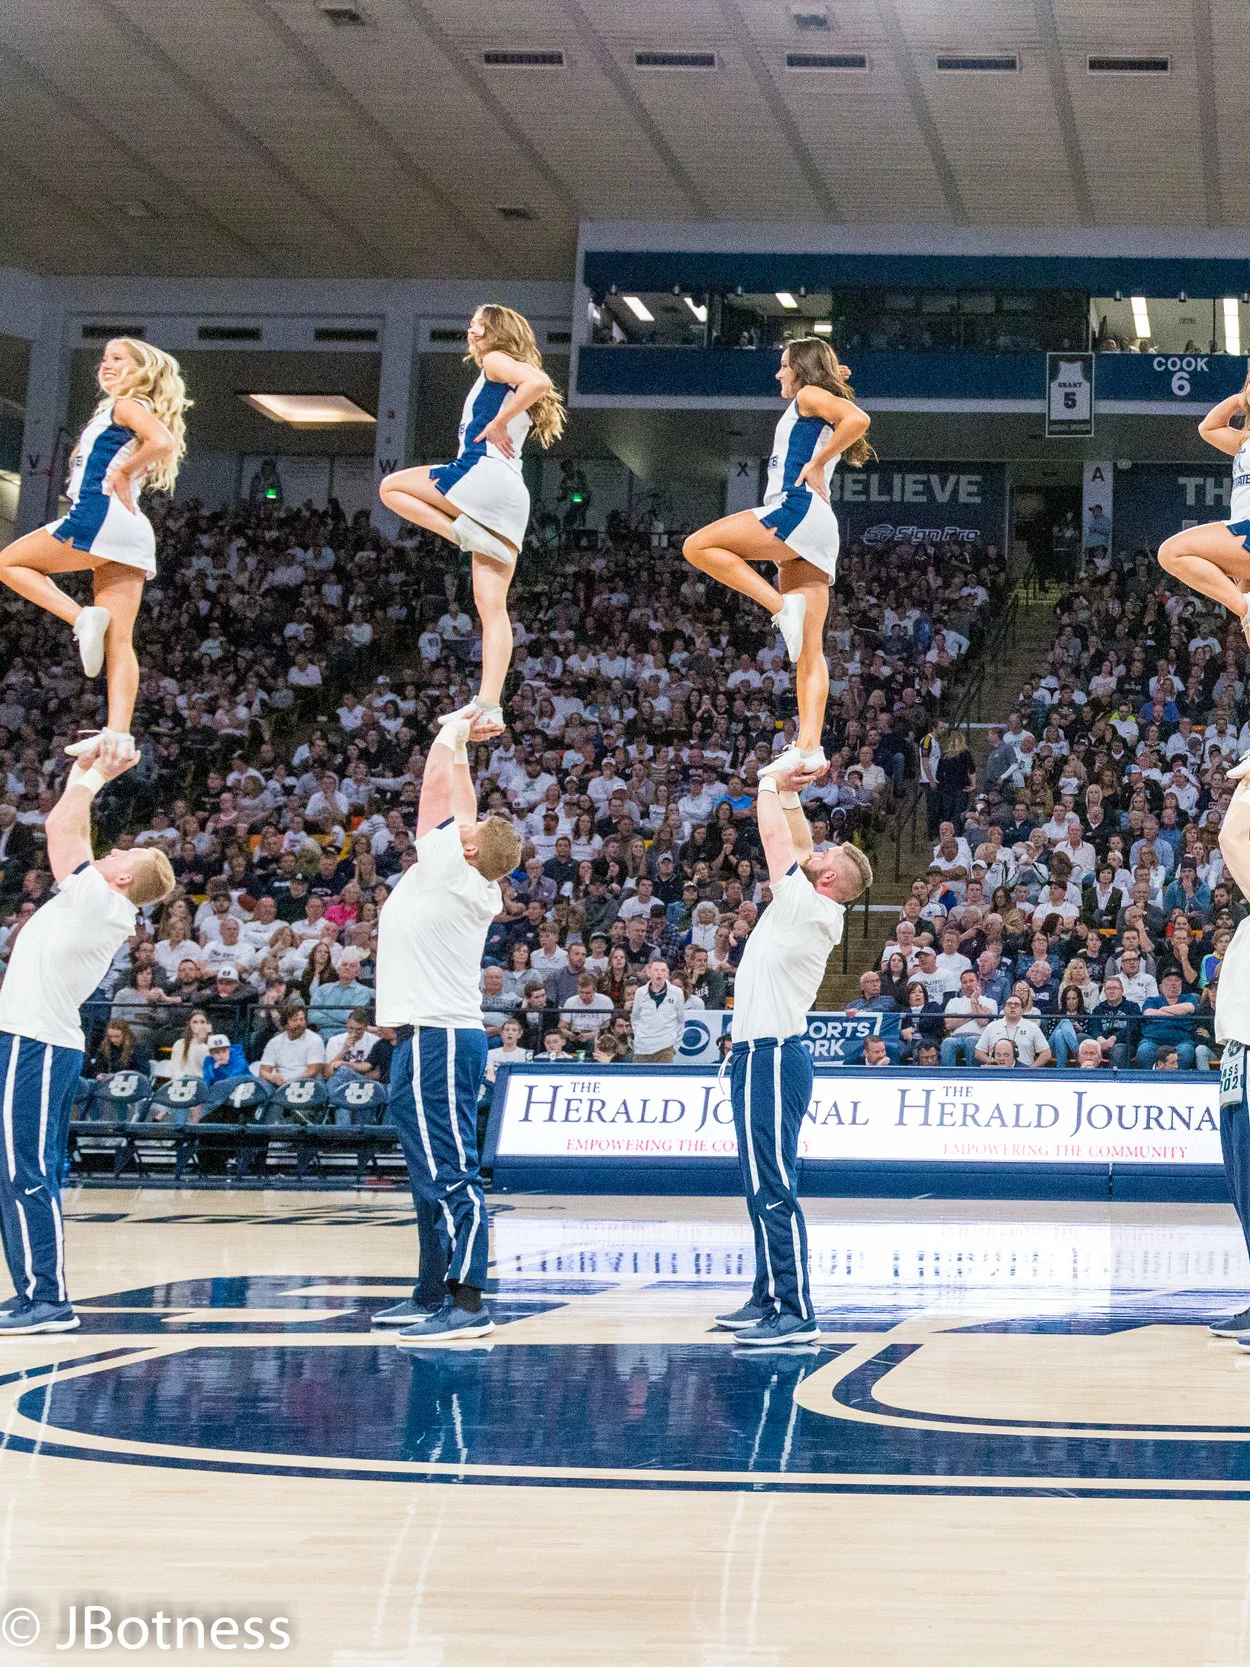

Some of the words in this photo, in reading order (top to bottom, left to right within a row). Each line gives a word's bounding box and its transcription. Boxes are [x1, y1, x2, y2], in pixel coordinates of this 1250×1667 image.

[1153, 357, 1209, 372] COOK
[1171, 372, 1191, 397] 6
[1064, 391, 1077, 409] 5
[379, 458, 398, 473] W
[737, 462, 749, 477] X
[1091, 467, 1105, 482] A
[1178, 477, 1232, 506] TH
[894, 526, 941, 545] Sign
[942, 526, 980, 542] Pro
[570, 1082, 601, 1093] THE
[943, 1086, 973, 1097] THE
[518, 1085, 686, 1124] HERALD
[695, 1086, 870, 1132] JONAL
[894, 1088, 1059, 1129] HERALD
[1069, 1091, 1219, 1137] JOURNA
[566, 1138, 673, 1152] EMPOWERING
[678, 1139, 708, 1152] THE
[943, 1143, 1049, 1157] EMPOWERING
[1056, 1145, 1084, 1158] THE
[1088, 1145, 1188, 1159] COMMUNITY
